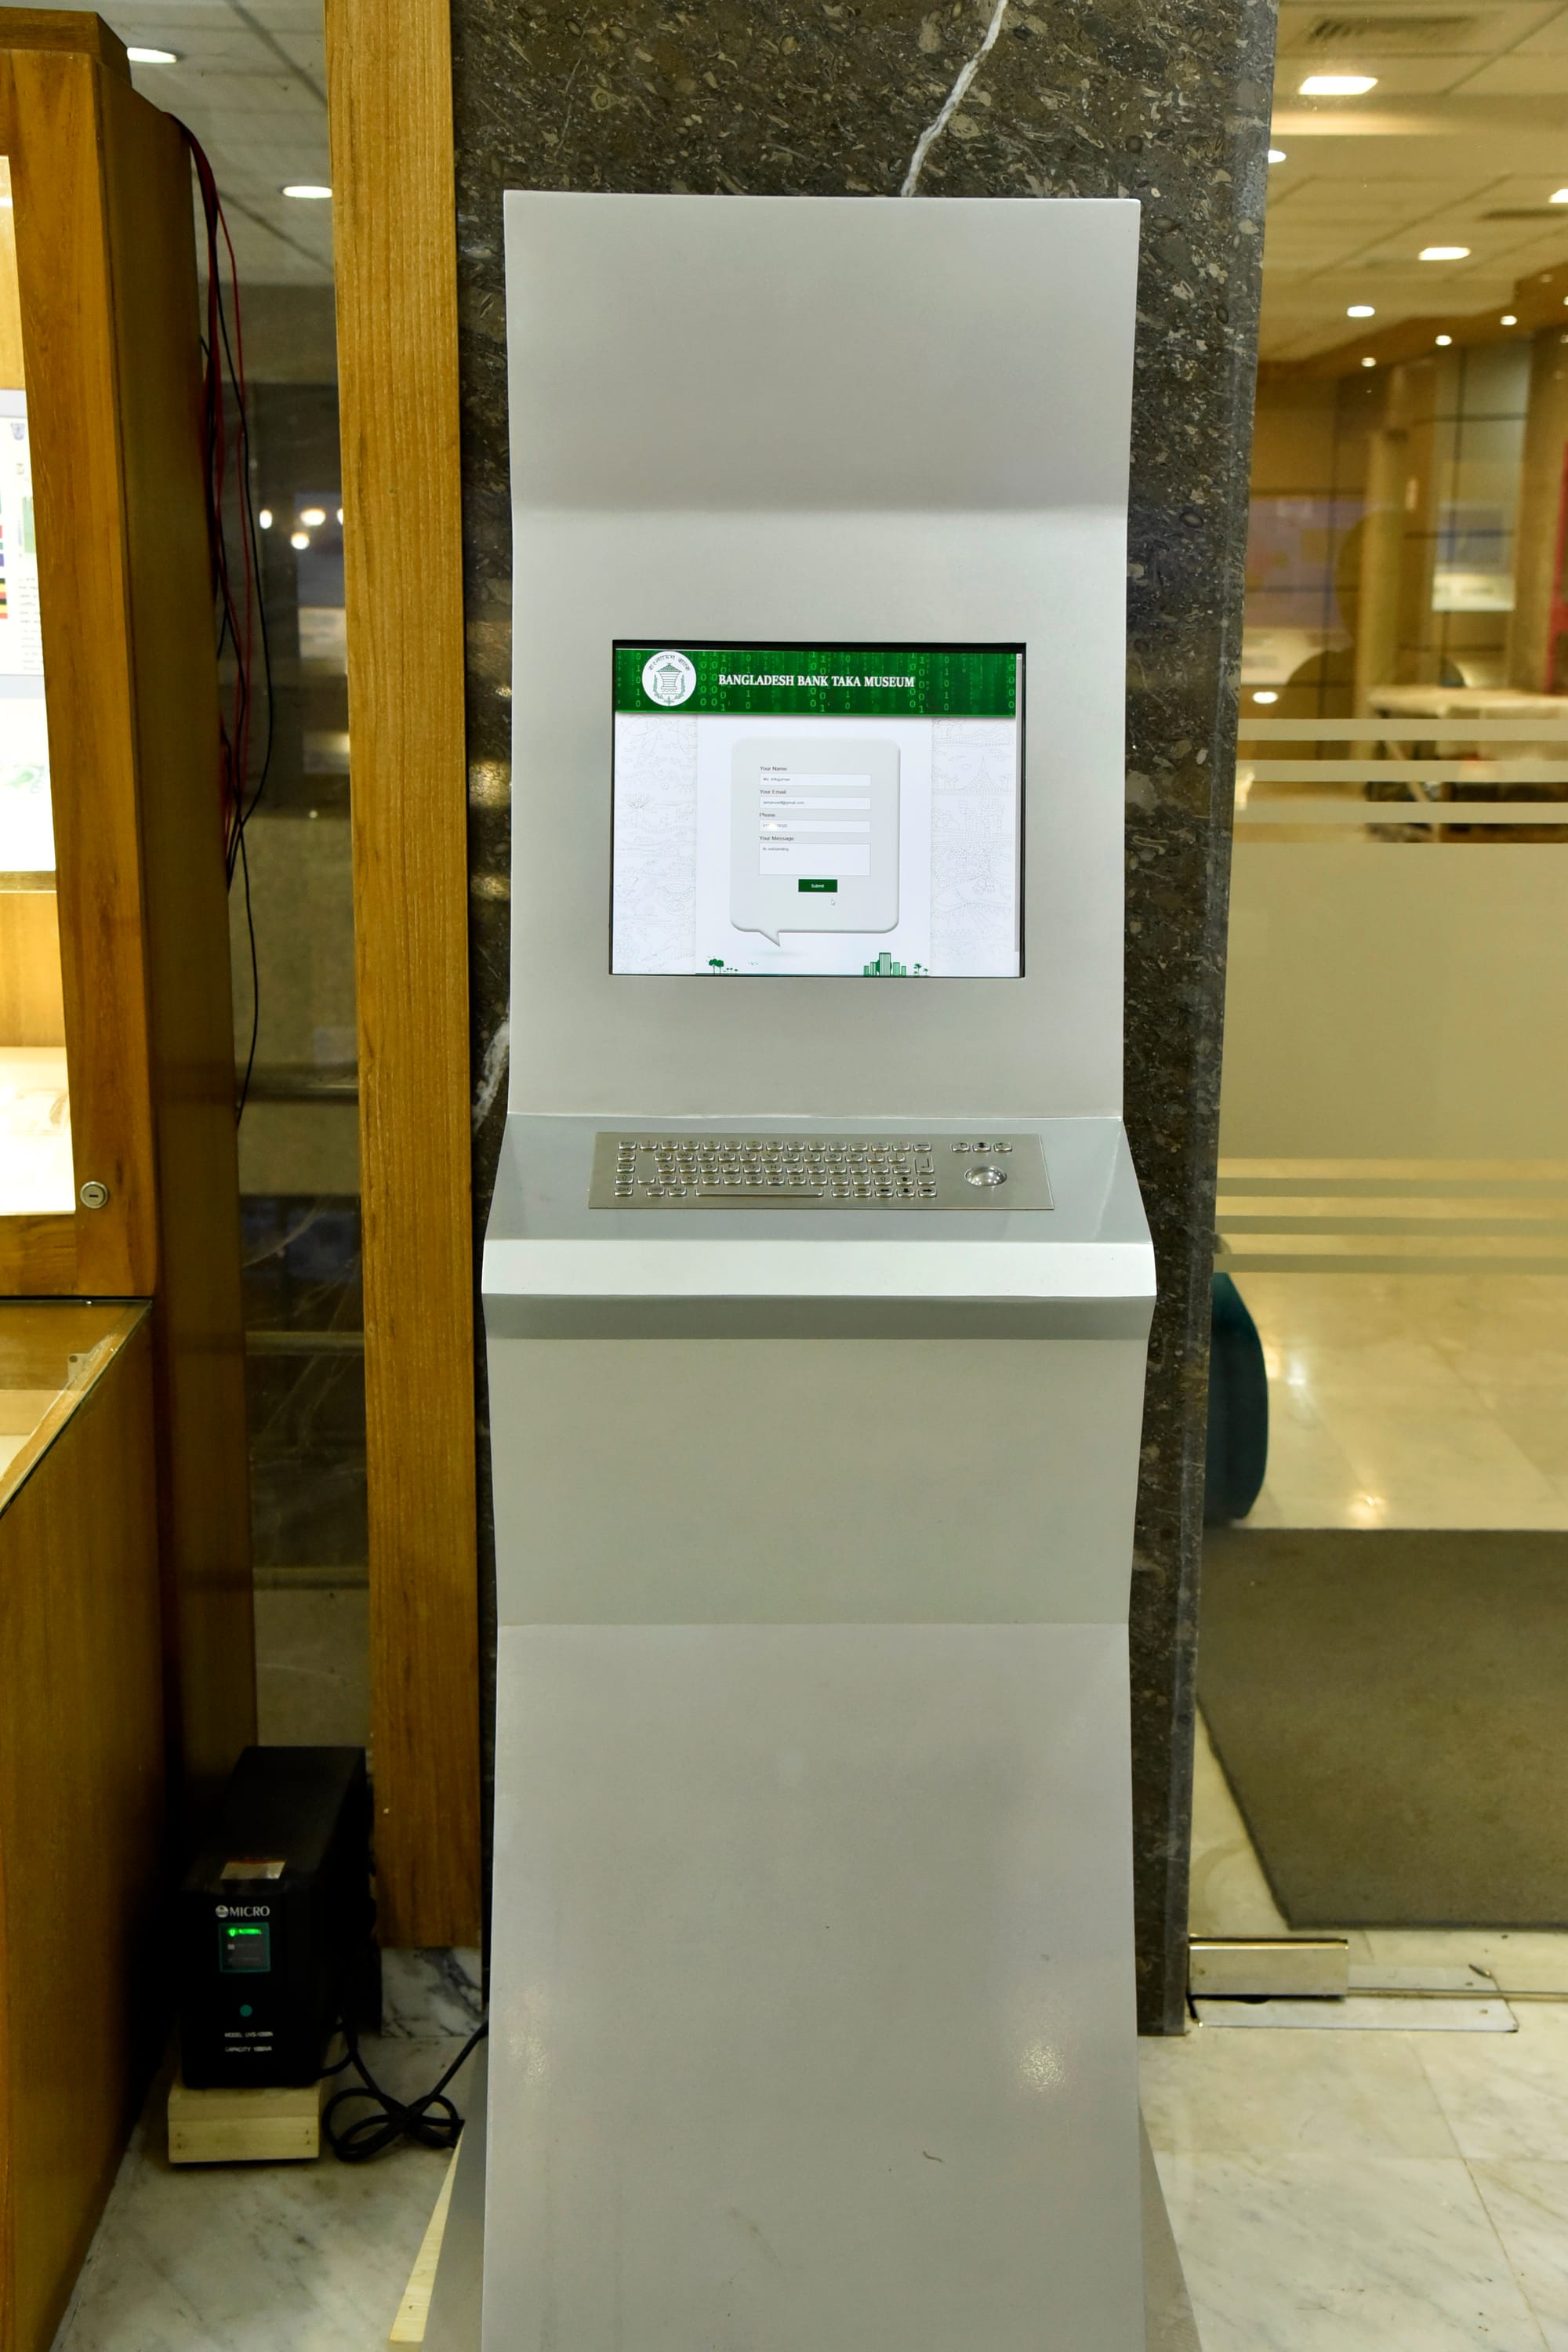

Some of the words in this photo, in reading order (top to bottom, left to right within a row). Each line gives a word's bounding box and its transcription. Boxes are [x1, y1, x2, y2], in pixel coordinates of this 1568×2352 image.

[718, 674, 794, 686] BANGLADESH
[797, 675, 829, 687] BANK
[831, 676, 862, 687] TAKA
[864, 676, 915, 688] MUSEUM
[230, 1906, 270, 1918] MICRO
